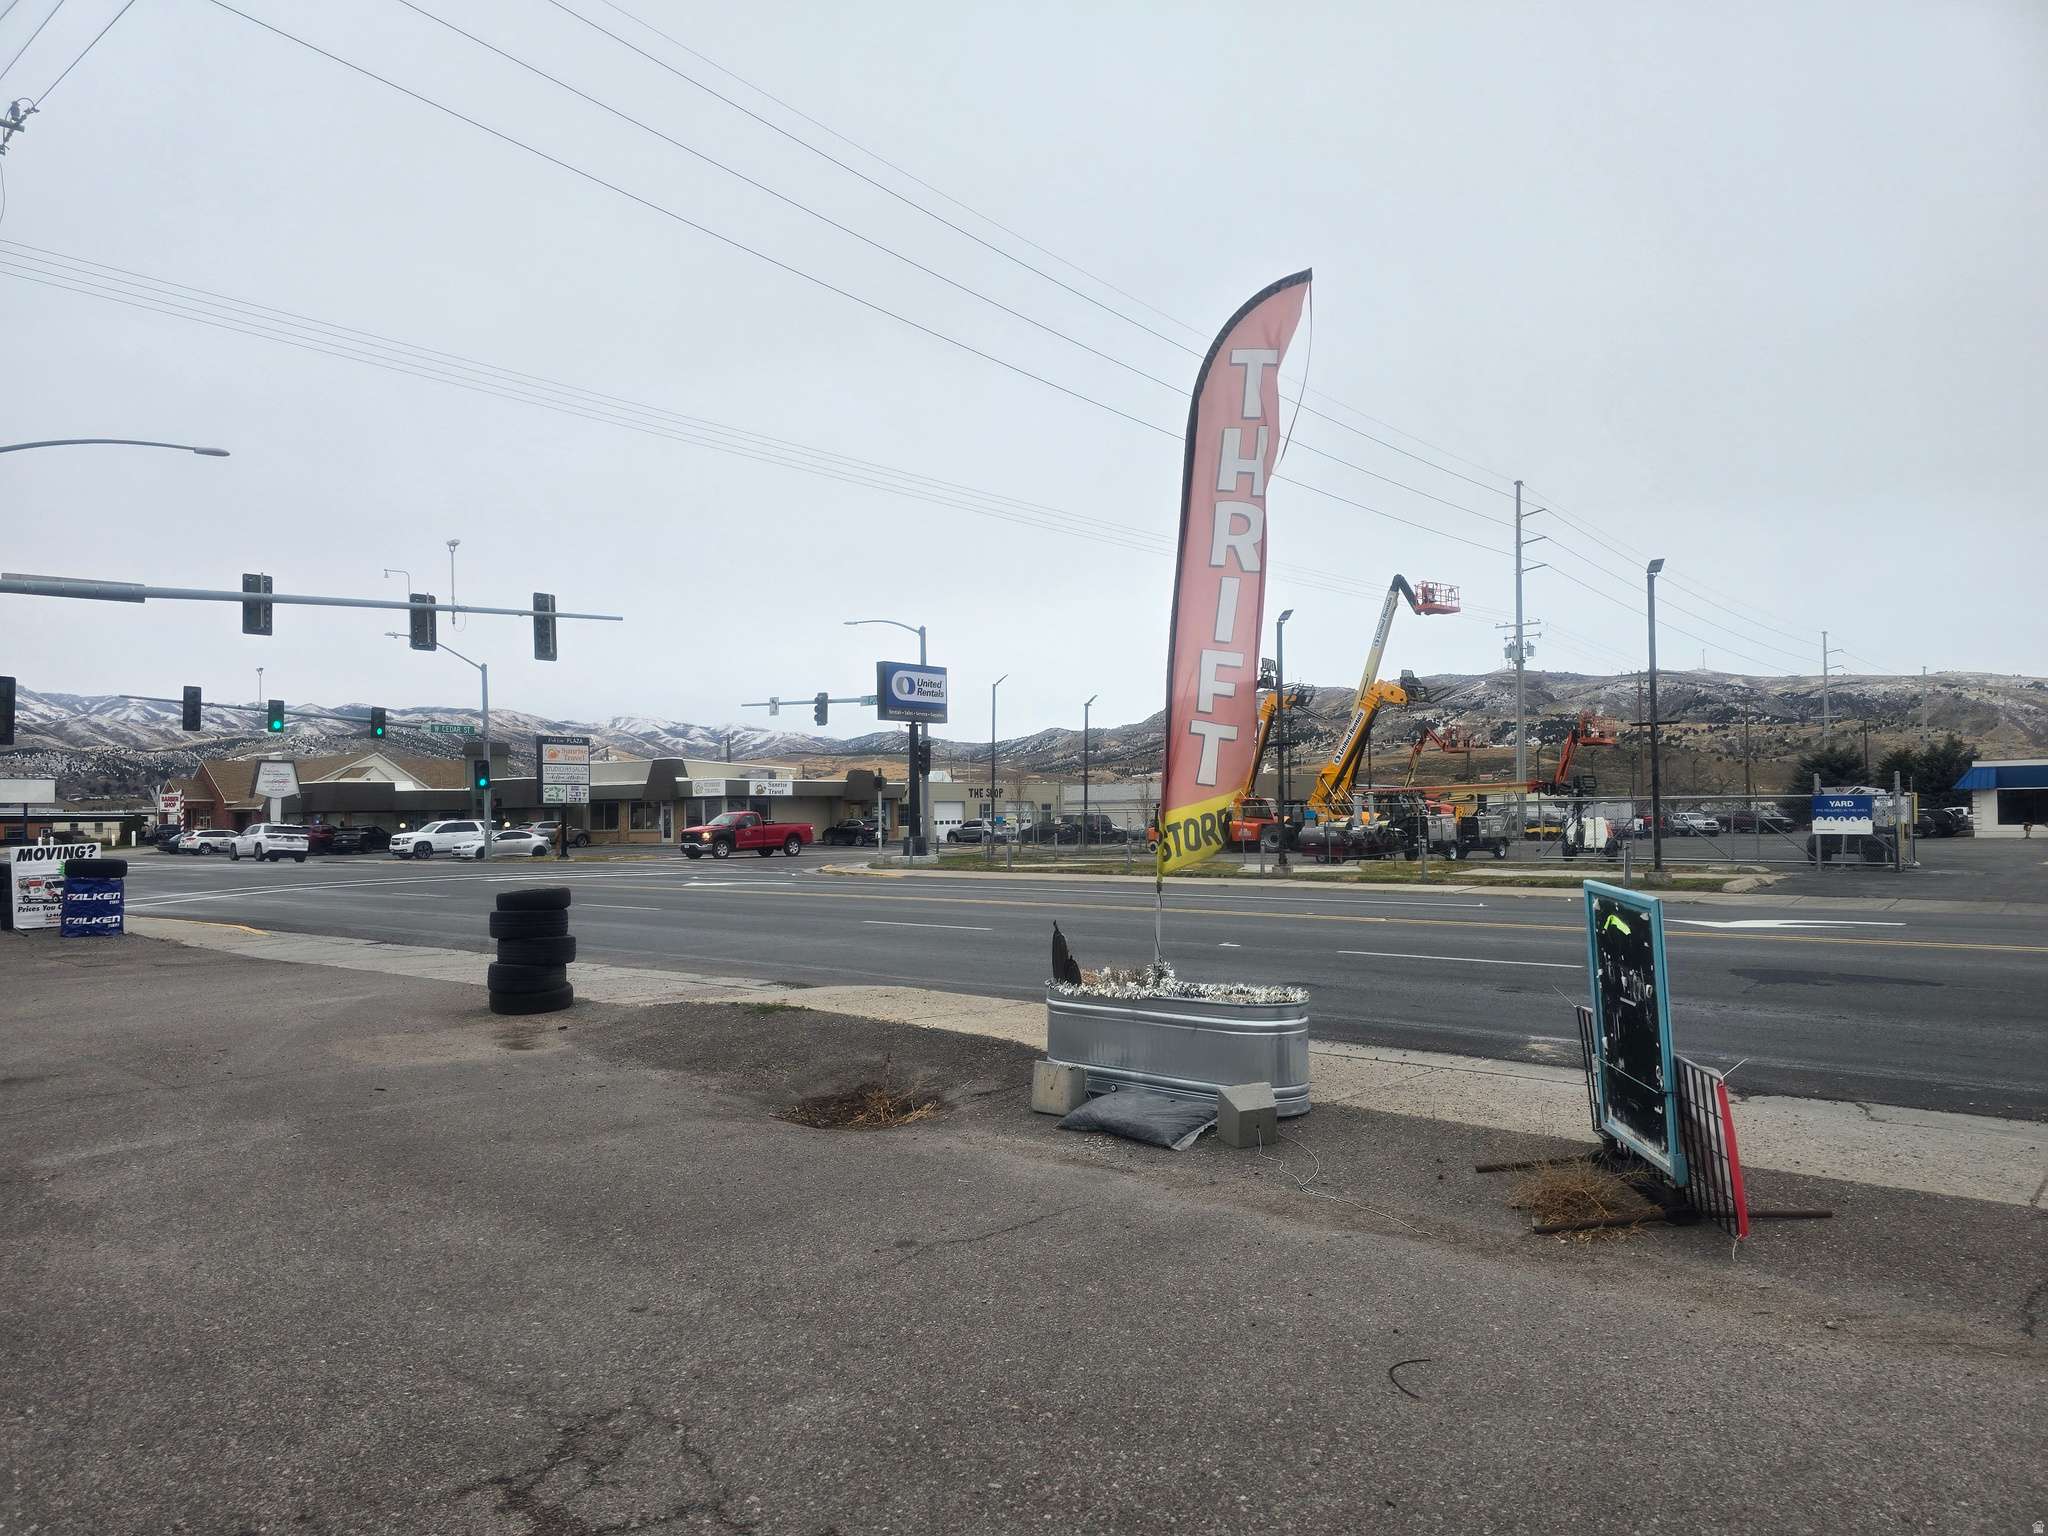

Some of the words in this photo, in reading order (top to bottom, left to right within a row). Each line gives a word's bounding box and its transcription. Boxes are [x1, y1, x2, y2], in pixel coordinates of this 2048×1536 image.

[1189, 347, 1281, 787] THRIFT
[916, 677, 943, 689] United
[916, 687, 945, 698] Rentals
[441, 725, 461, 733] CEDAR
[463, 726, 471, 734] ST
[1338, 733, 1352, 756] United
[1349, 711, 1364, 735] Rentals
[968, 787, 984, 798] THE
[986, 787, 1004, 798] SOP
[16, 845, 97, 862] MOVING?
[67, 892, 121, 901] FALKEN
[17, 905, 41, 913] Prices
[65, 914, 121, 925] FALKEN
